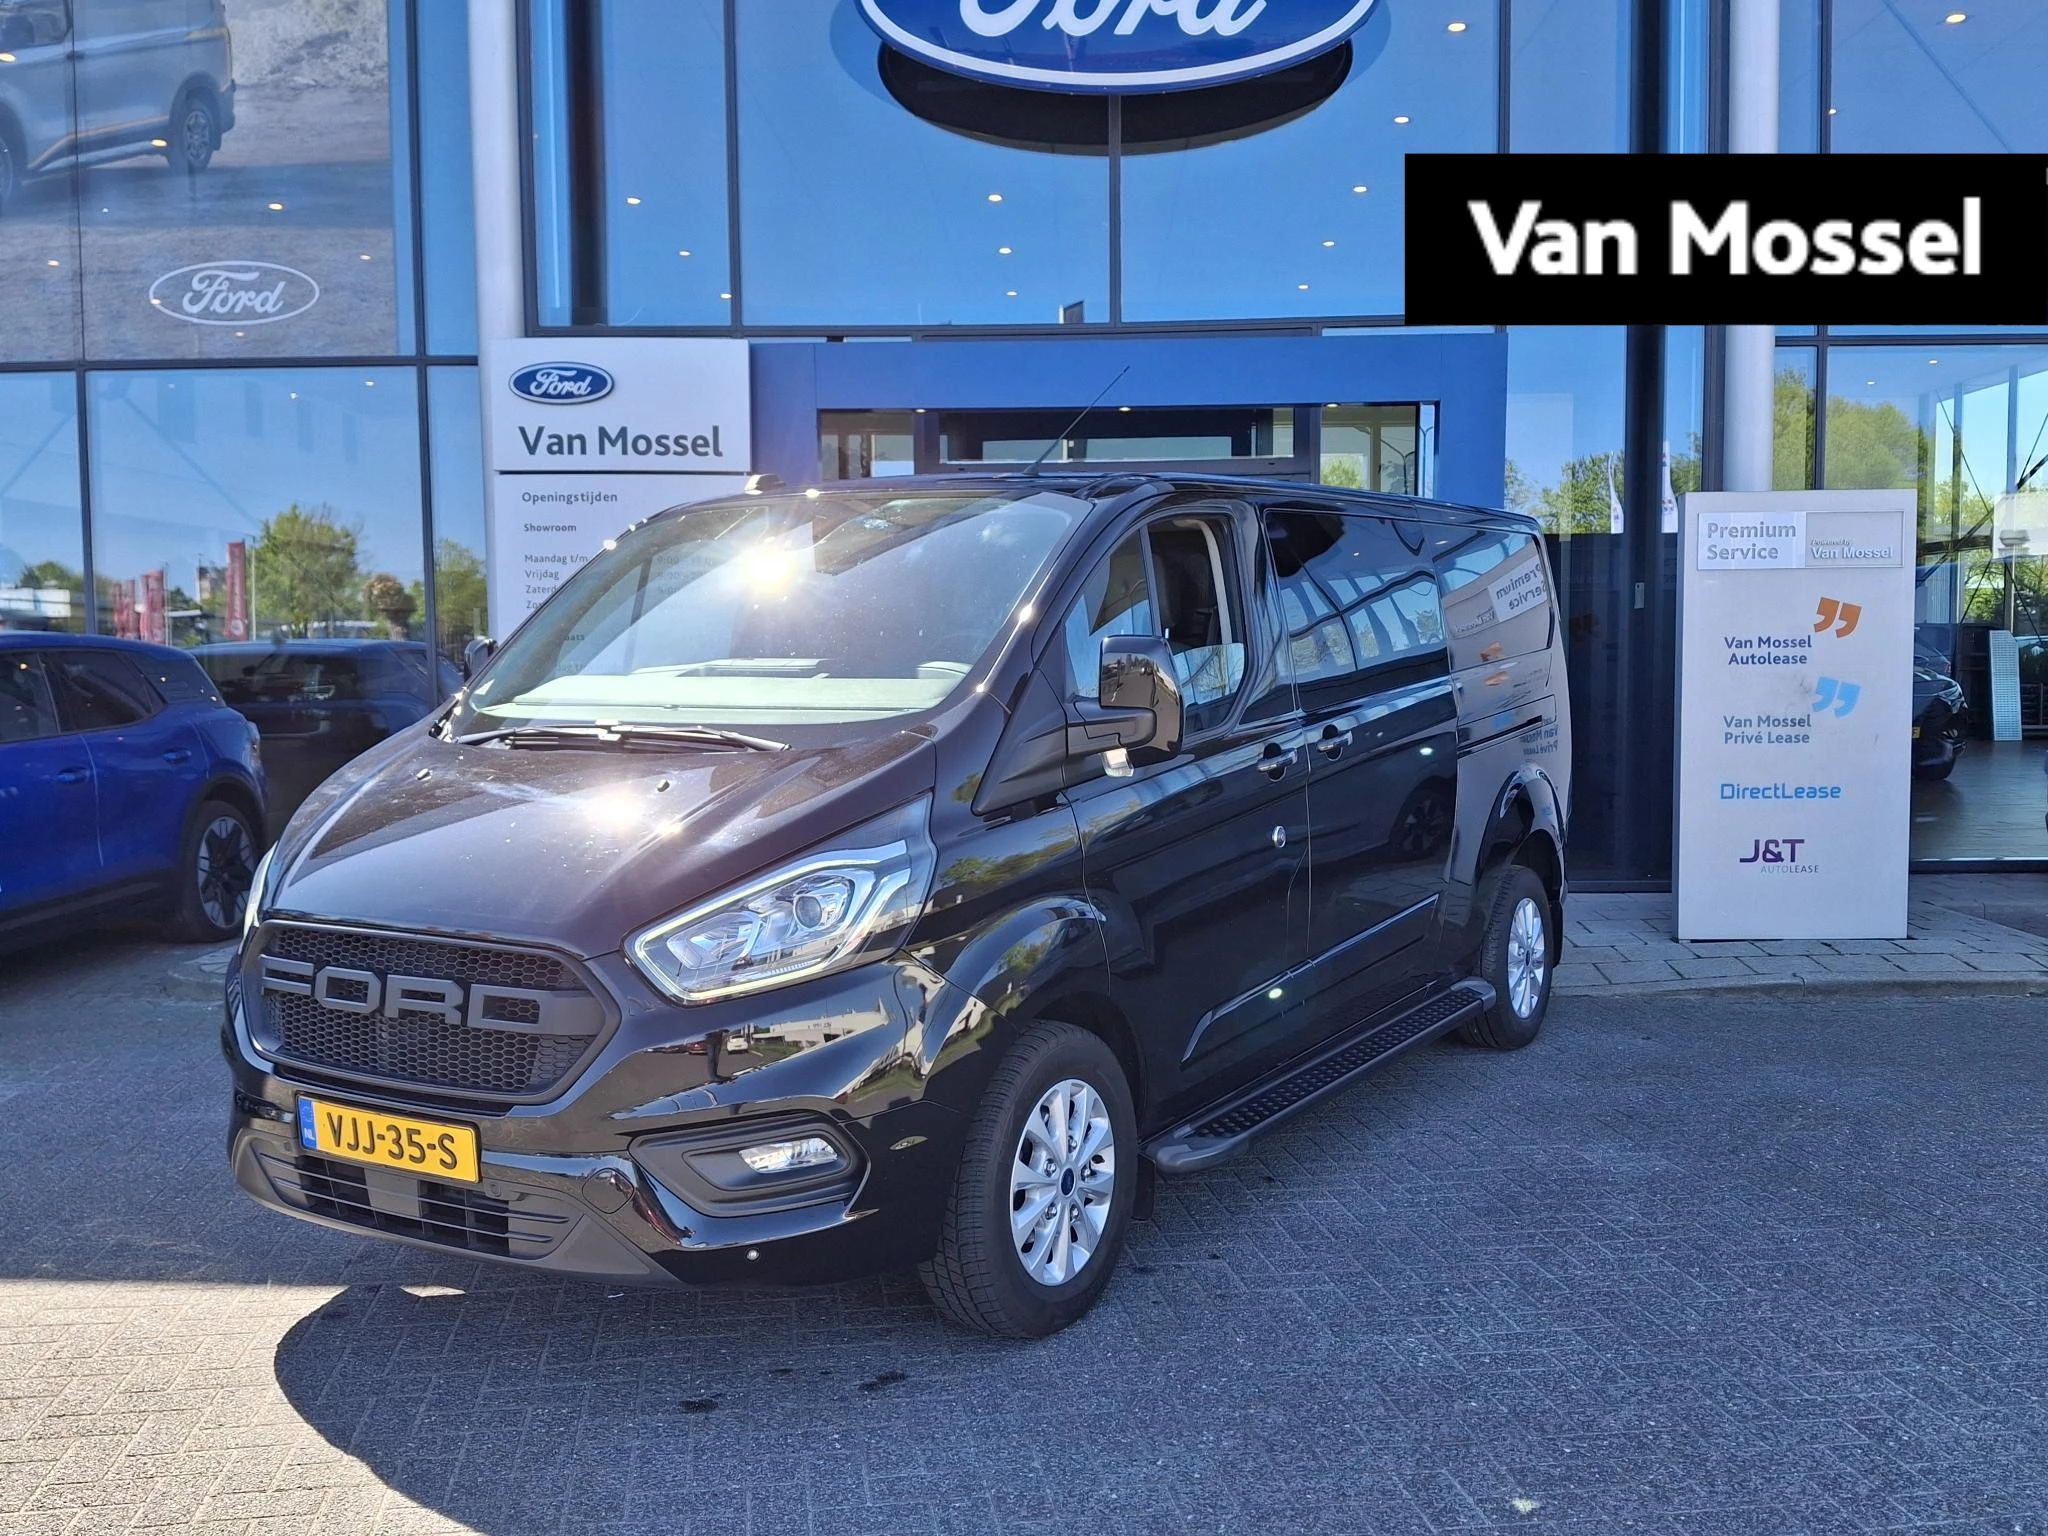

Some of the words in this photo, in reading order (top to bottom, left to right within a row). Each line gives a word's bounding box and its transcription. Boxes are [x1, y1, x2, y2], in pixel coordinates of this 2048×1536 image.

[182, 270, 286, 313] Ford
[529, 368, 593, 397] Ford
[518, 426, 587, 456] Van
[598, 425, 723, 457] Mossel
[522, 492, 618, 504] Openingstijden
[524, 523, 577, 532] Showroom
[1707, 521, 1797, 539] Premium
[1707, 543, 1779, 561] Service
[1810, 546, 1838, 559] Van
[1842, 546, 1893, 559] Mossel
[524, 554, 567, 565] Maandag
[525, 569, 560, 581] Vrijdag
[526, 585, 557, 595] Zaterd
[1724, 636, 1753, 649] Van
[1757, 635, 1812, 649] Mossel
[1728, 651, 1808, 665] Autolease
[1723, 715, 1752, 728] Van
[1757, 714, 1812, 728] Mossel
[1724, 731, 1763, 744] Privé
[1767, 731, 1810, 744] Lease
[1720, 783, 1841, 800] DirectLease
[1740, 838, 1805, 863] J&T
[1760, 865, 1819, 873] AUTOLEASE
[259, 953, 555, 1036] FORD
[304, 1128, 316, 1141] NL
[325, 1111, 458, 1170] VJJ-35-S
